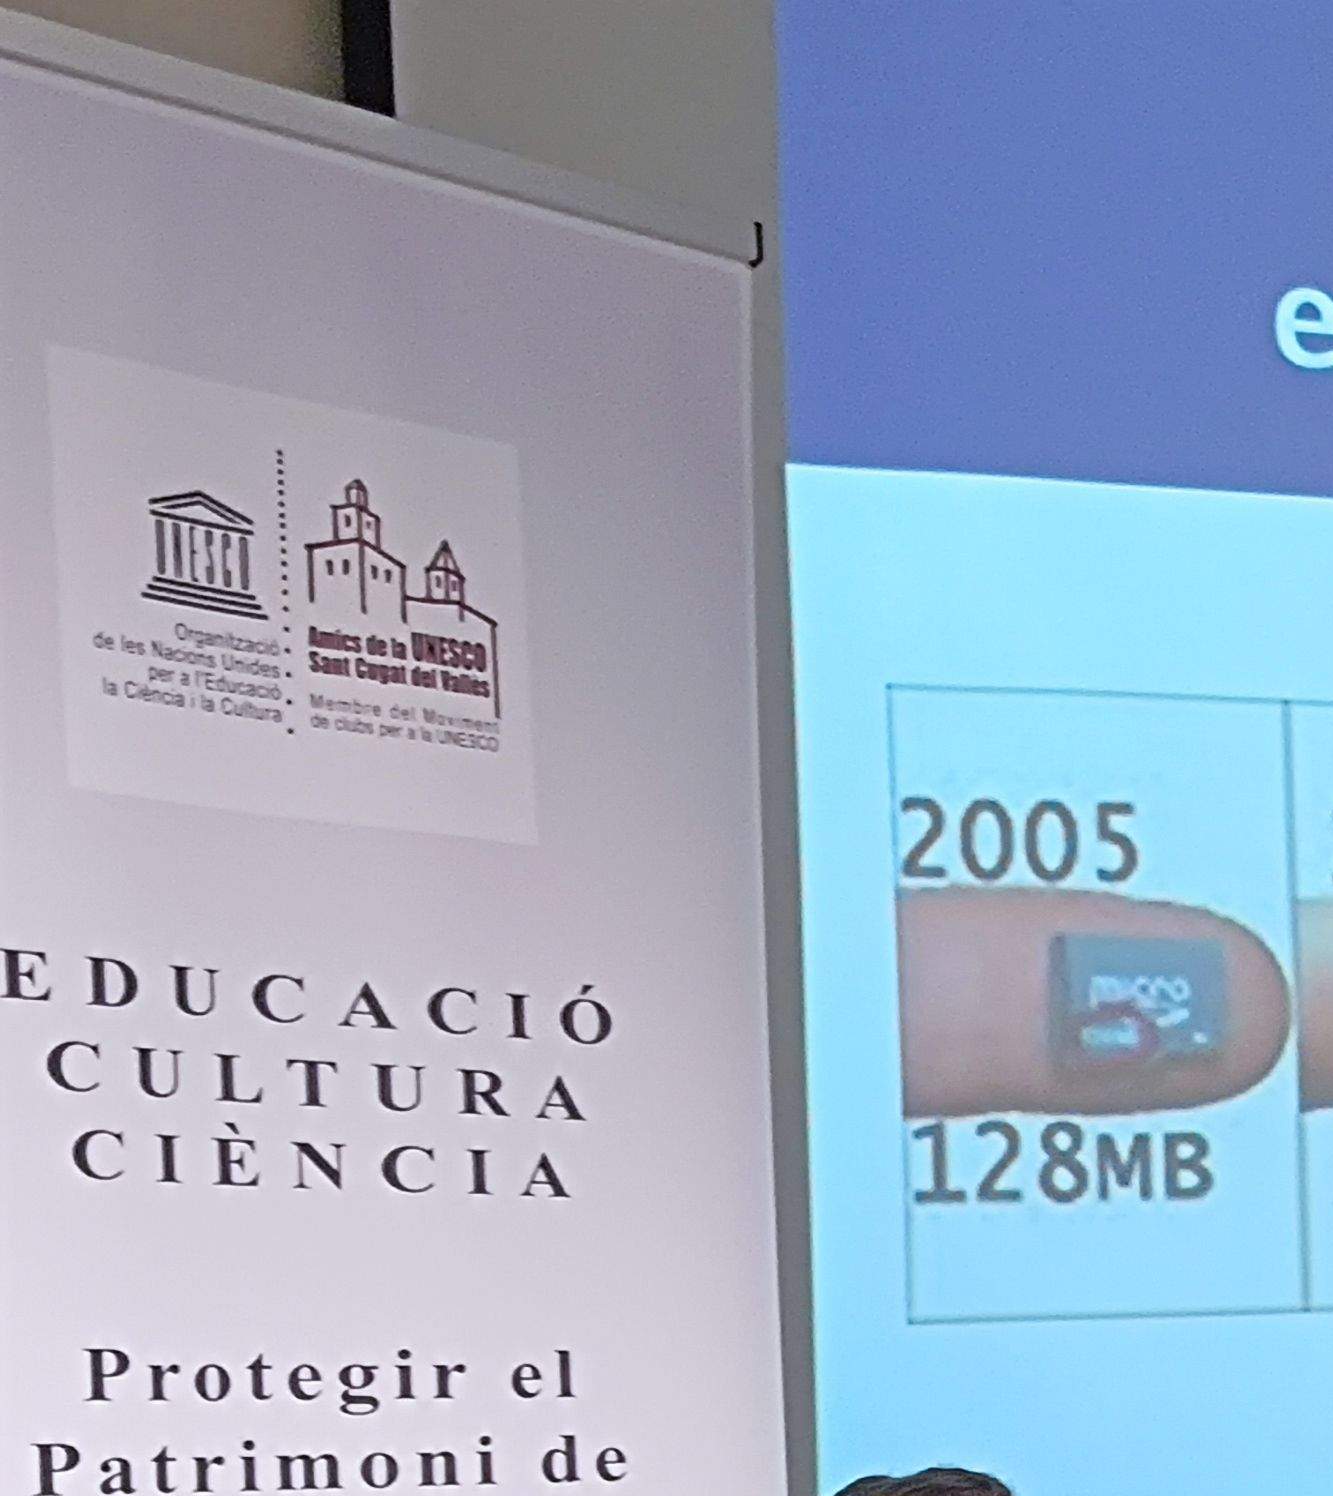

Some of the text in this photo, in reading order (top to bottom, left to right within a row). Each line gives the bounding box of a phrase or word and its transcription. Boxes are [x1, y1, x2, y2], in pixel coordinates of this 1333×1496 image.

[93, 631, 115, 650] de
[121, 635, 146, 655] les
[222, 653, 281, 678] Unides
[149, 667, 175, 683] per
[180, 673, 190, 686] a
[309, 651, 350, 676] Sant
[355, 658, 407, 684] Cugat
[411, 666, 437, 690] del
[366, 635, 387, 656] de
[391, 638, 407, 660] la
[411, 632, 486, 672] UNESCO
[103, 677, 118, 696] la
[201, 694, 214, 712] la
[221, 697, 282, 722] Cultura
[390, 704, 416, 721] del
[311, 714, 330, 729] de
[379, 725, 402, 737] per
[408, 728, 416, 739] a
[421, 727, 432, 742] la
[438, 730, 499, 752] UNESCO
[900, 796, 1139, 883] 2005
[0, 948, 613, 1045] EDUCACIÓ
[46, 1041, 587, 1121] CULTURA
[71, 1122, 571, 1198] CIÈNCIA
[912, 1120, 1214, 1204] 128MB
[82, 1348, 577, 1416] Protegir el
[30, 1434, 629, 1496] Patrimoni de
